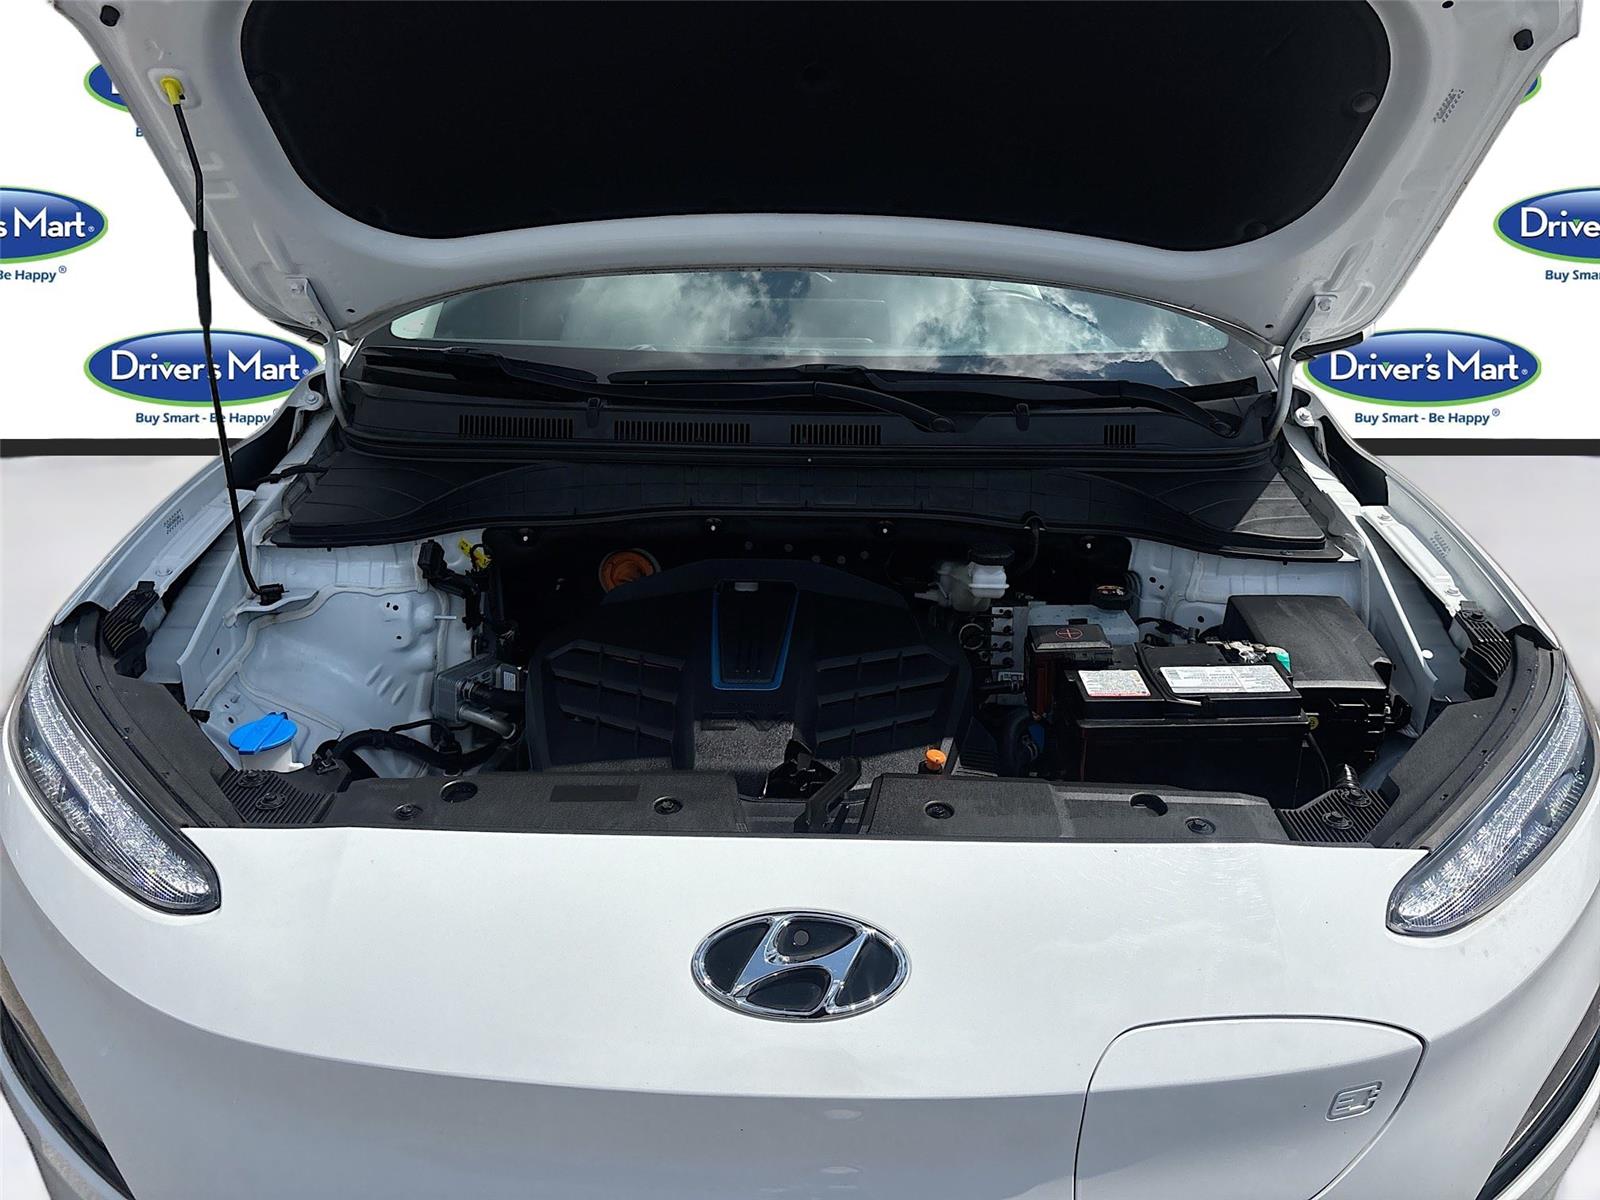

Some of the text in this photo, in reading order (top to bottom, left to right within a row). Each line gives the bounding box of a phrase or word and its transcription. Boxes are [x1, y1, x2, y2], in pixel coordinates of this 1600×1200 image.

[1521, 207, 1600, 238] Drive
[15, 269, 57, 283] Happy
[1545, 269, 1600, 283] Buy Sma
[111, 349, 222, 381] Drivers
[1330, 349, 1441, 381] Driver's
[135, 412, 159, 426] Buy
[163, 412, 200, 423] Smart
[1354, 412, 1378, 426] Buy
[1382, 412, 1418, 423] Smart
[1429, 412, 1445, 423] Be
[1448, 412, 1490, 426] Happy
